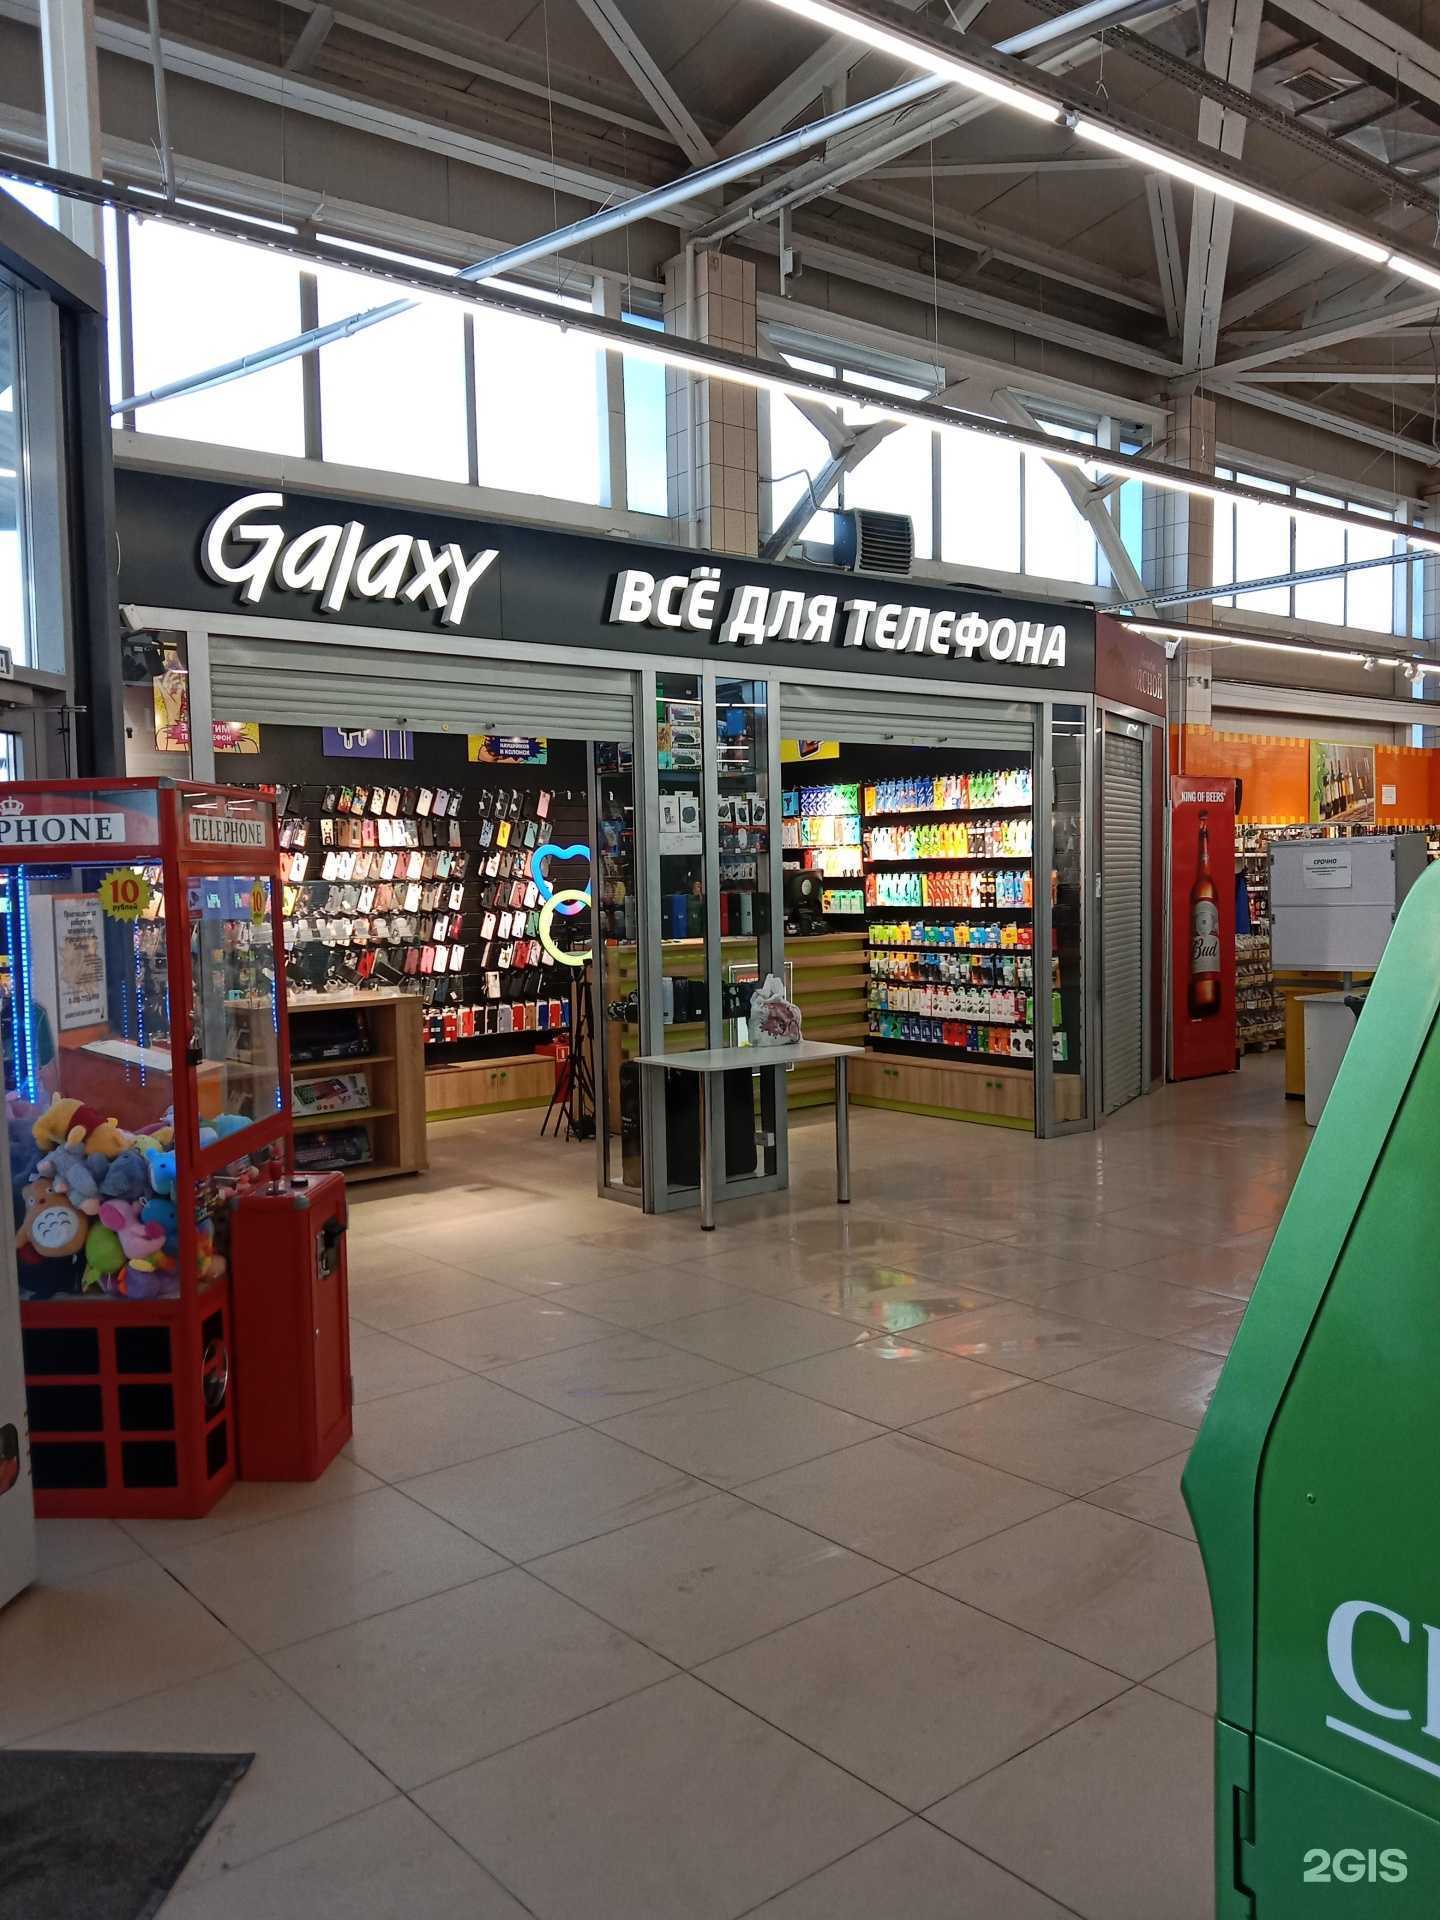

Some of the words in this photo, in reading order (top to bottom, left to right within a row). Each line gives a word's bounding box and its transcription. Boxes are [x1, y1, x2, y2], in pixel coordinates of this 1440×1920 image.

[201, 492, 499, 625] Galaxy
[609, 566, 721, 631] ВСЁ
[718, 584, 838, 645] ДЛЯ
[843, 598, 1067, 668] ТЕЛЕФОНА
[1133, 669, 1163, 699] ЯСНОЙ
[1181, 791, 1196, 802] KING
[1197, 791, 1206, 803] OF
[192, 818, 263, 844] TELEPHONE
[110, 879, 140, 904] 10
[252, 890, 262, 912] 10
[112, 903, 138, 912] рублей
[1193, 938, 1217, 960] Bud
